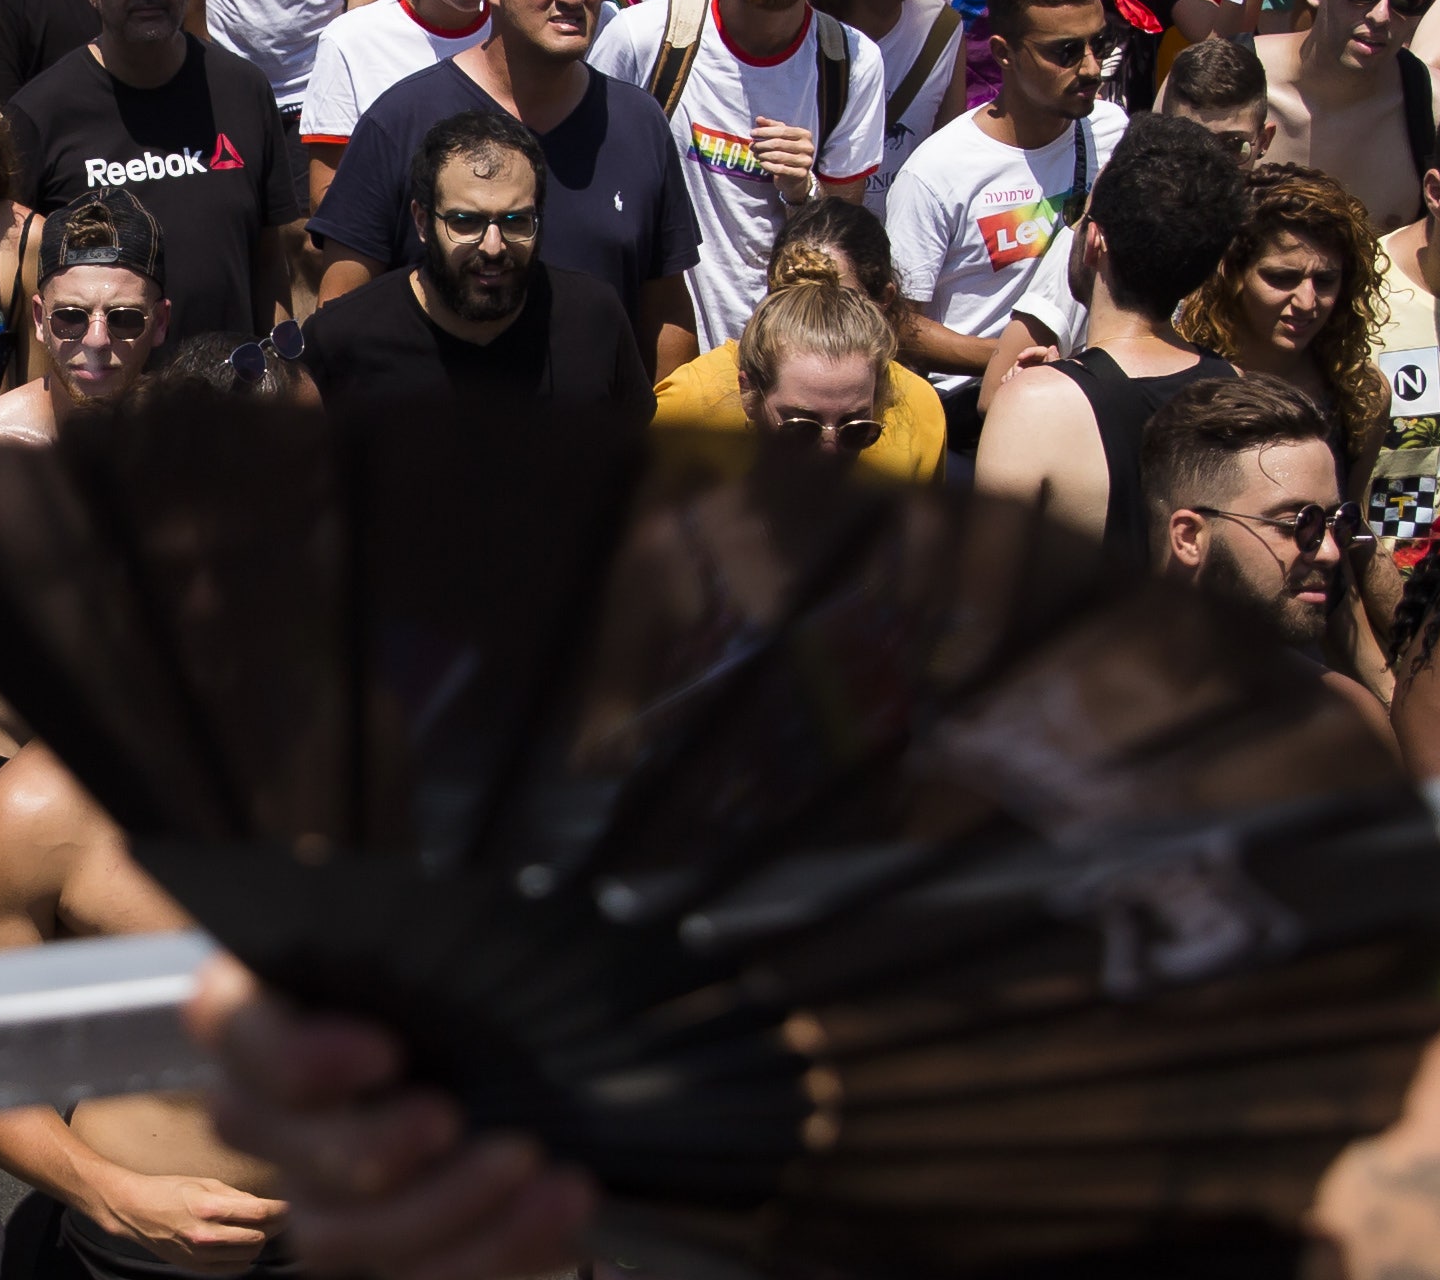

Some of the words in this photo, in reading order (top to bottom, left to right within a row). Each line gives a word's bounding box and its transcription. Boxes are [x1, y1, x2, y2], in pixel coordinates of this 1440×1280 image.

[85, 147, 208, 188] Reebok
[985, 188, 1035, 204] שרמוטה
[996, 213, 1057, 252] Lev
